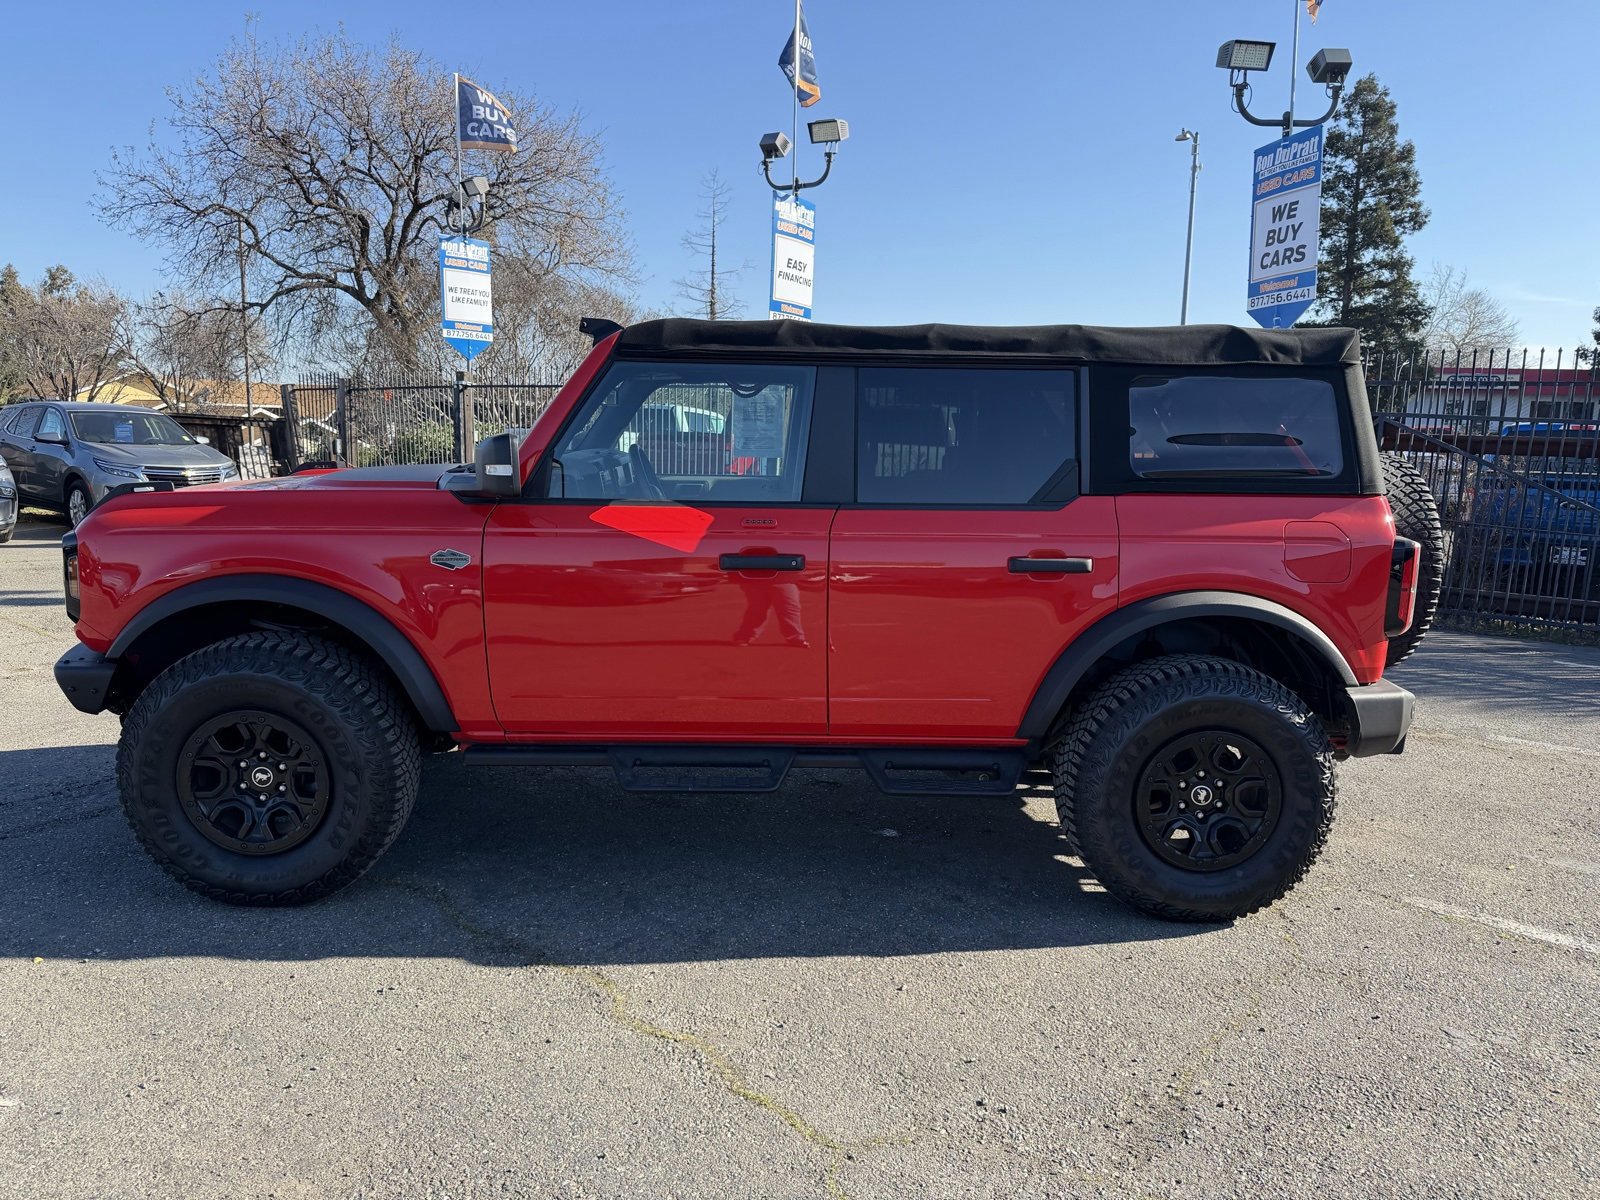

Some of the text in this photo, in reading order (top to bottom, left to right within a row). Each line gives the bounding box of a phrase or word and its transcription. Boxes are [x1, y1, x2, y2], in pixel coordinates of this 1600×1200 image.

[473, 105, 508, 124] BUY
[467, 122, 517, 142] CARS
[1255, 153, 1275, 173] Ron
[1256, 166, 1316, 195] USED CARS
[1272, 199, 1299, 224] WE
[1265, 222, 1304, 247] BUY
[786, 258, 808, 273] EASY
[1260, 244, 1307, 270] CARS
[777, 270, 812, 288] FINANCING
[448, 286, 490, 298] WE TREAT YOU
[451, 296, 489, 307] LIKE FAMILY!
[1250, 288, 1311, 308] 877.756.6441
[446, 329, 491, 341] 877.756.6441
